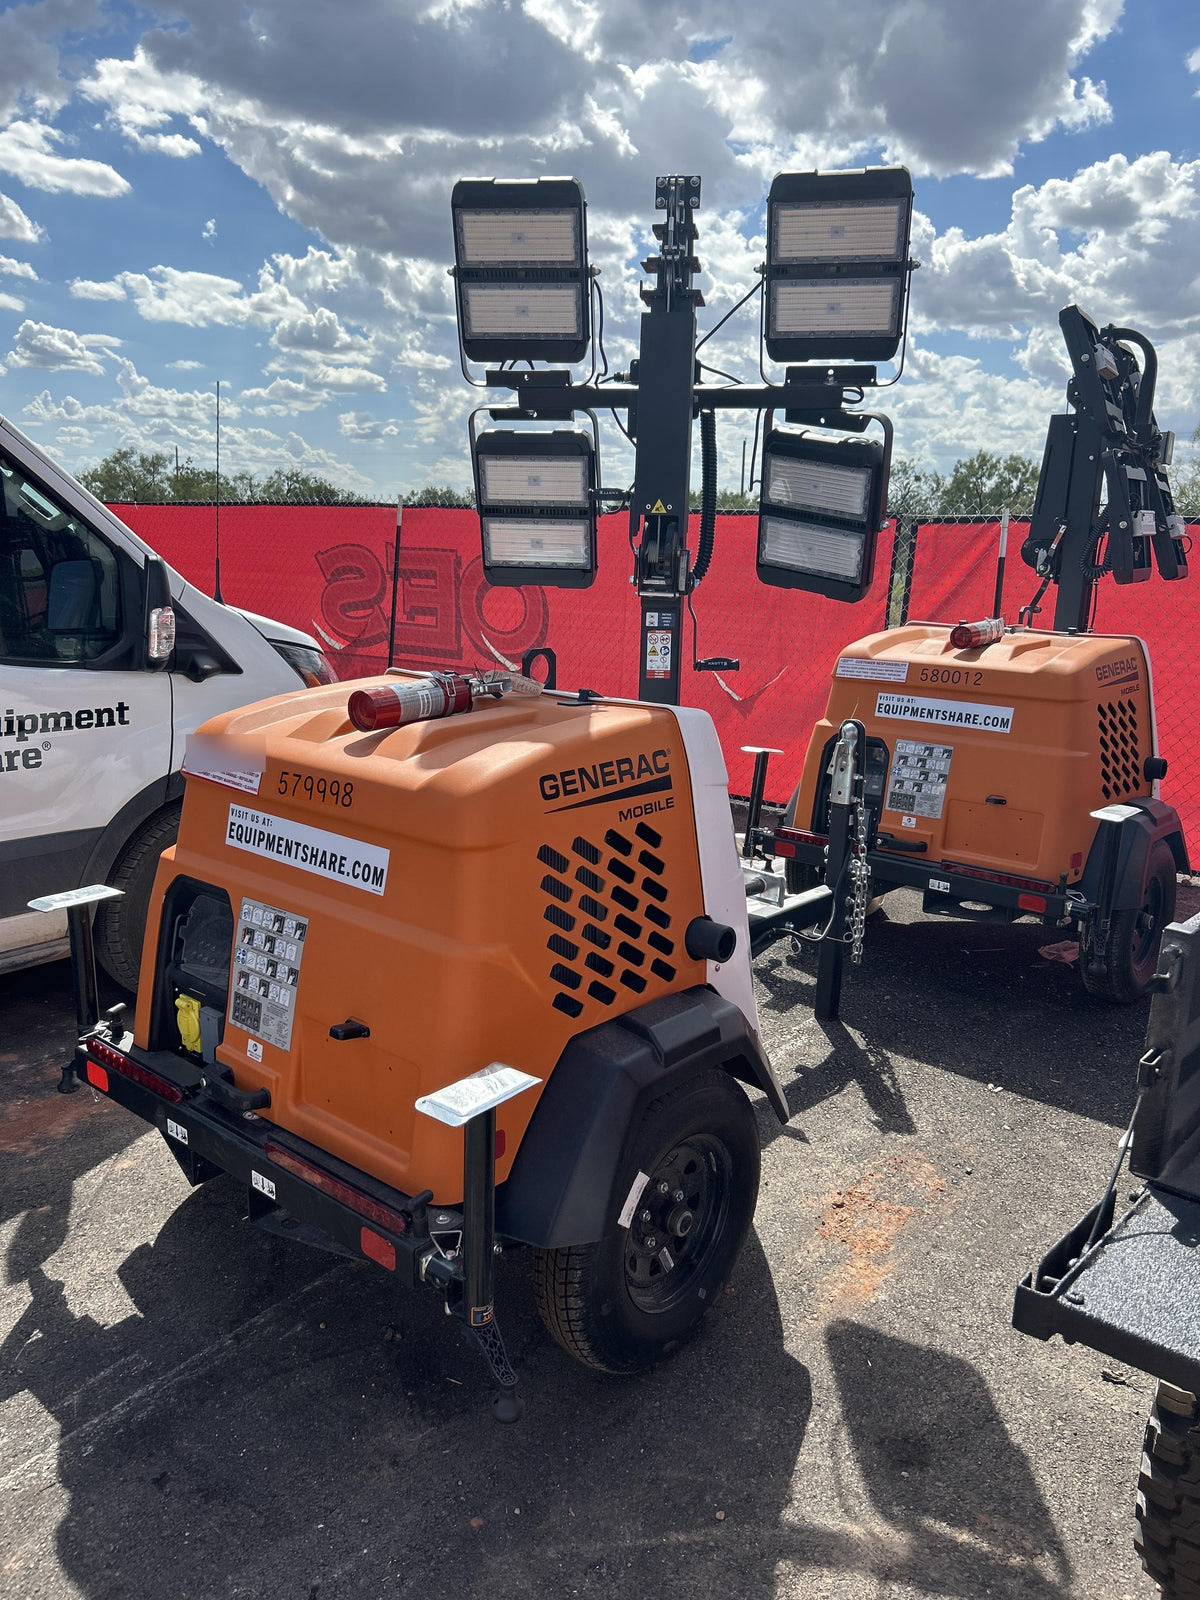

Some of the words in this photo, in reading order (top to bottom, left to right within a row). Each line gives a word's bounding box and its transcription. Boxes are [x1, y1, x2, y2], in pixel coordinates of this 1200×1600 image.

[920, 668, 983, 686] 580012
[1096, 657, 1137, 681] GENERAC
[0, 702, 130, 743] ipment
[877, 703, 1010, 729] EQUIPMENTSHARE.COM
[539, 749, 670, 801] GENERAC
[278, 771, 354, 808] 579998
[230, 807, 249, 820] VISIT
[250, 813, 260, 823] US
[262, 817, 273, 827] AT:
[618, 796, 675, 822] MOBILE
[228, 821, 385, 888] EQUIPMENTSHARE.COM
